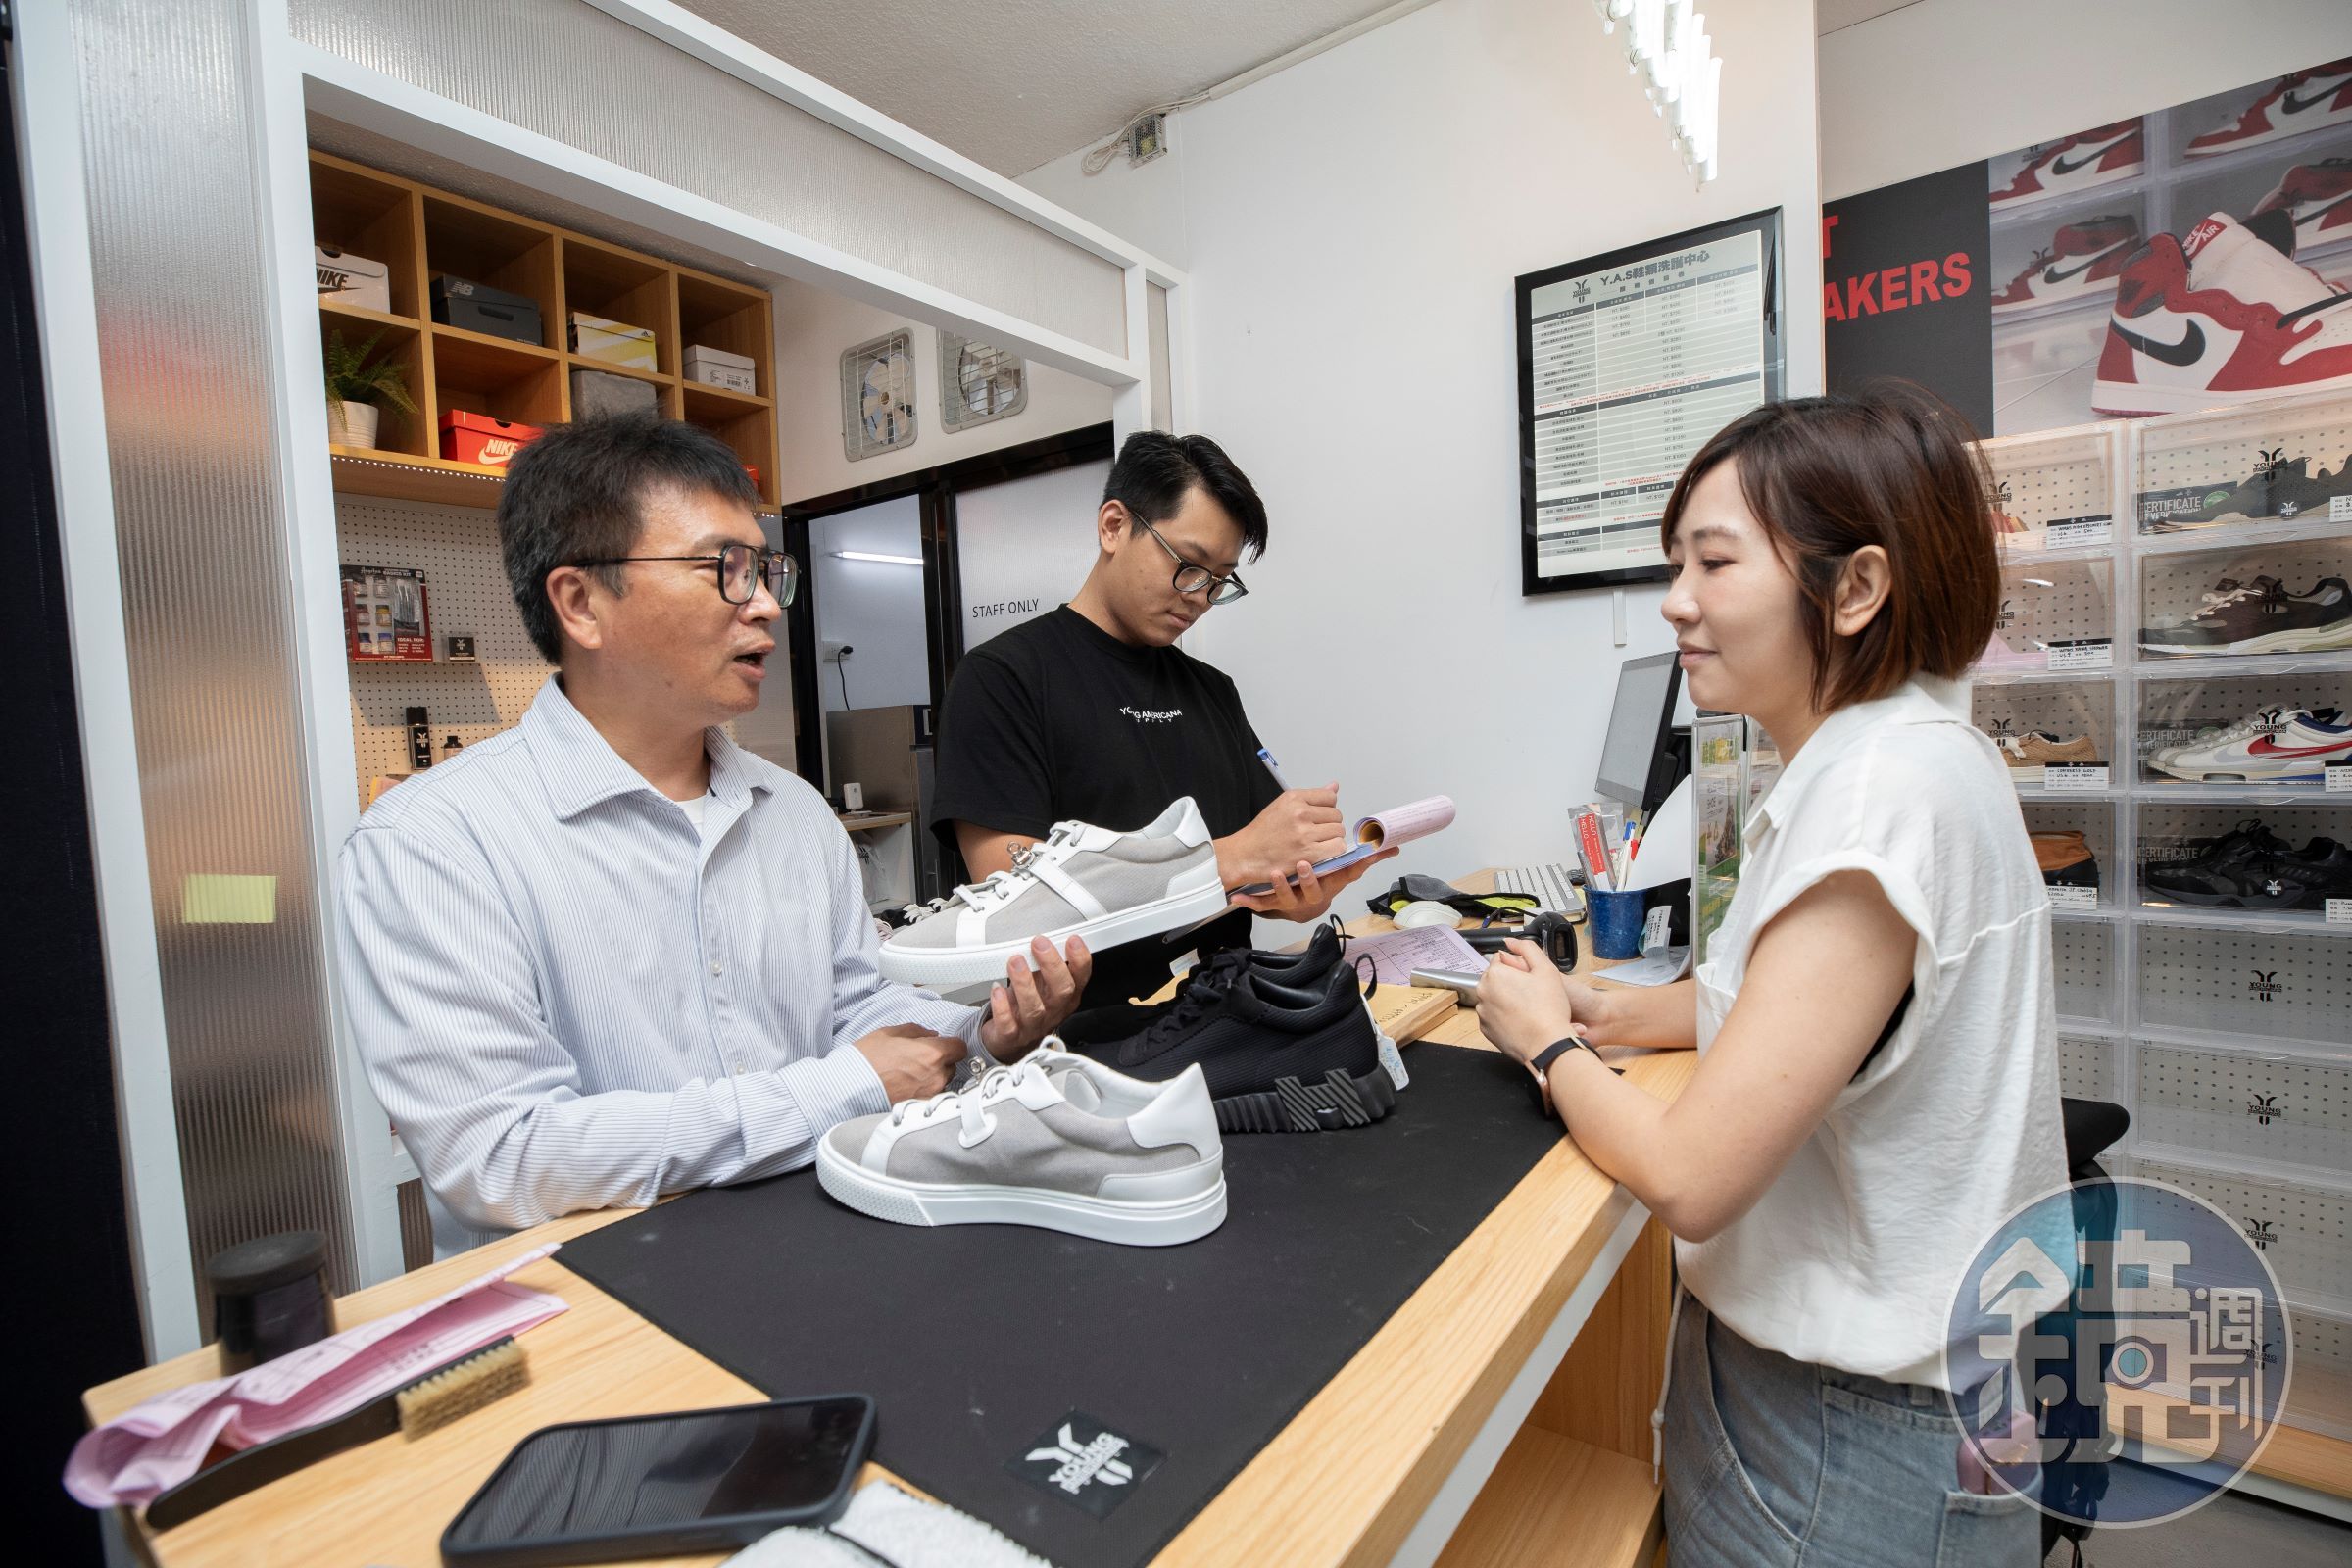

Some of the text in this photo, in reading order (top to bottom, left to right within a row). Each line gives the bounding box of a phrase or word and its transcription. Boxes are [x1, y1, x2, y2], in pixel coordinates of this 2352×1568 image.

[2201, 224, 2220, 241] AIR
[1824, 252, 1972, 321] AKERS
[972, 598, 1040, 618] STAFF ONLY
[1589, 815, 1597, 836] HELLO
[2249, 1104, 2281, 1113] YOUNG
[2245, 1228, 2278, 1239] YOUNG
